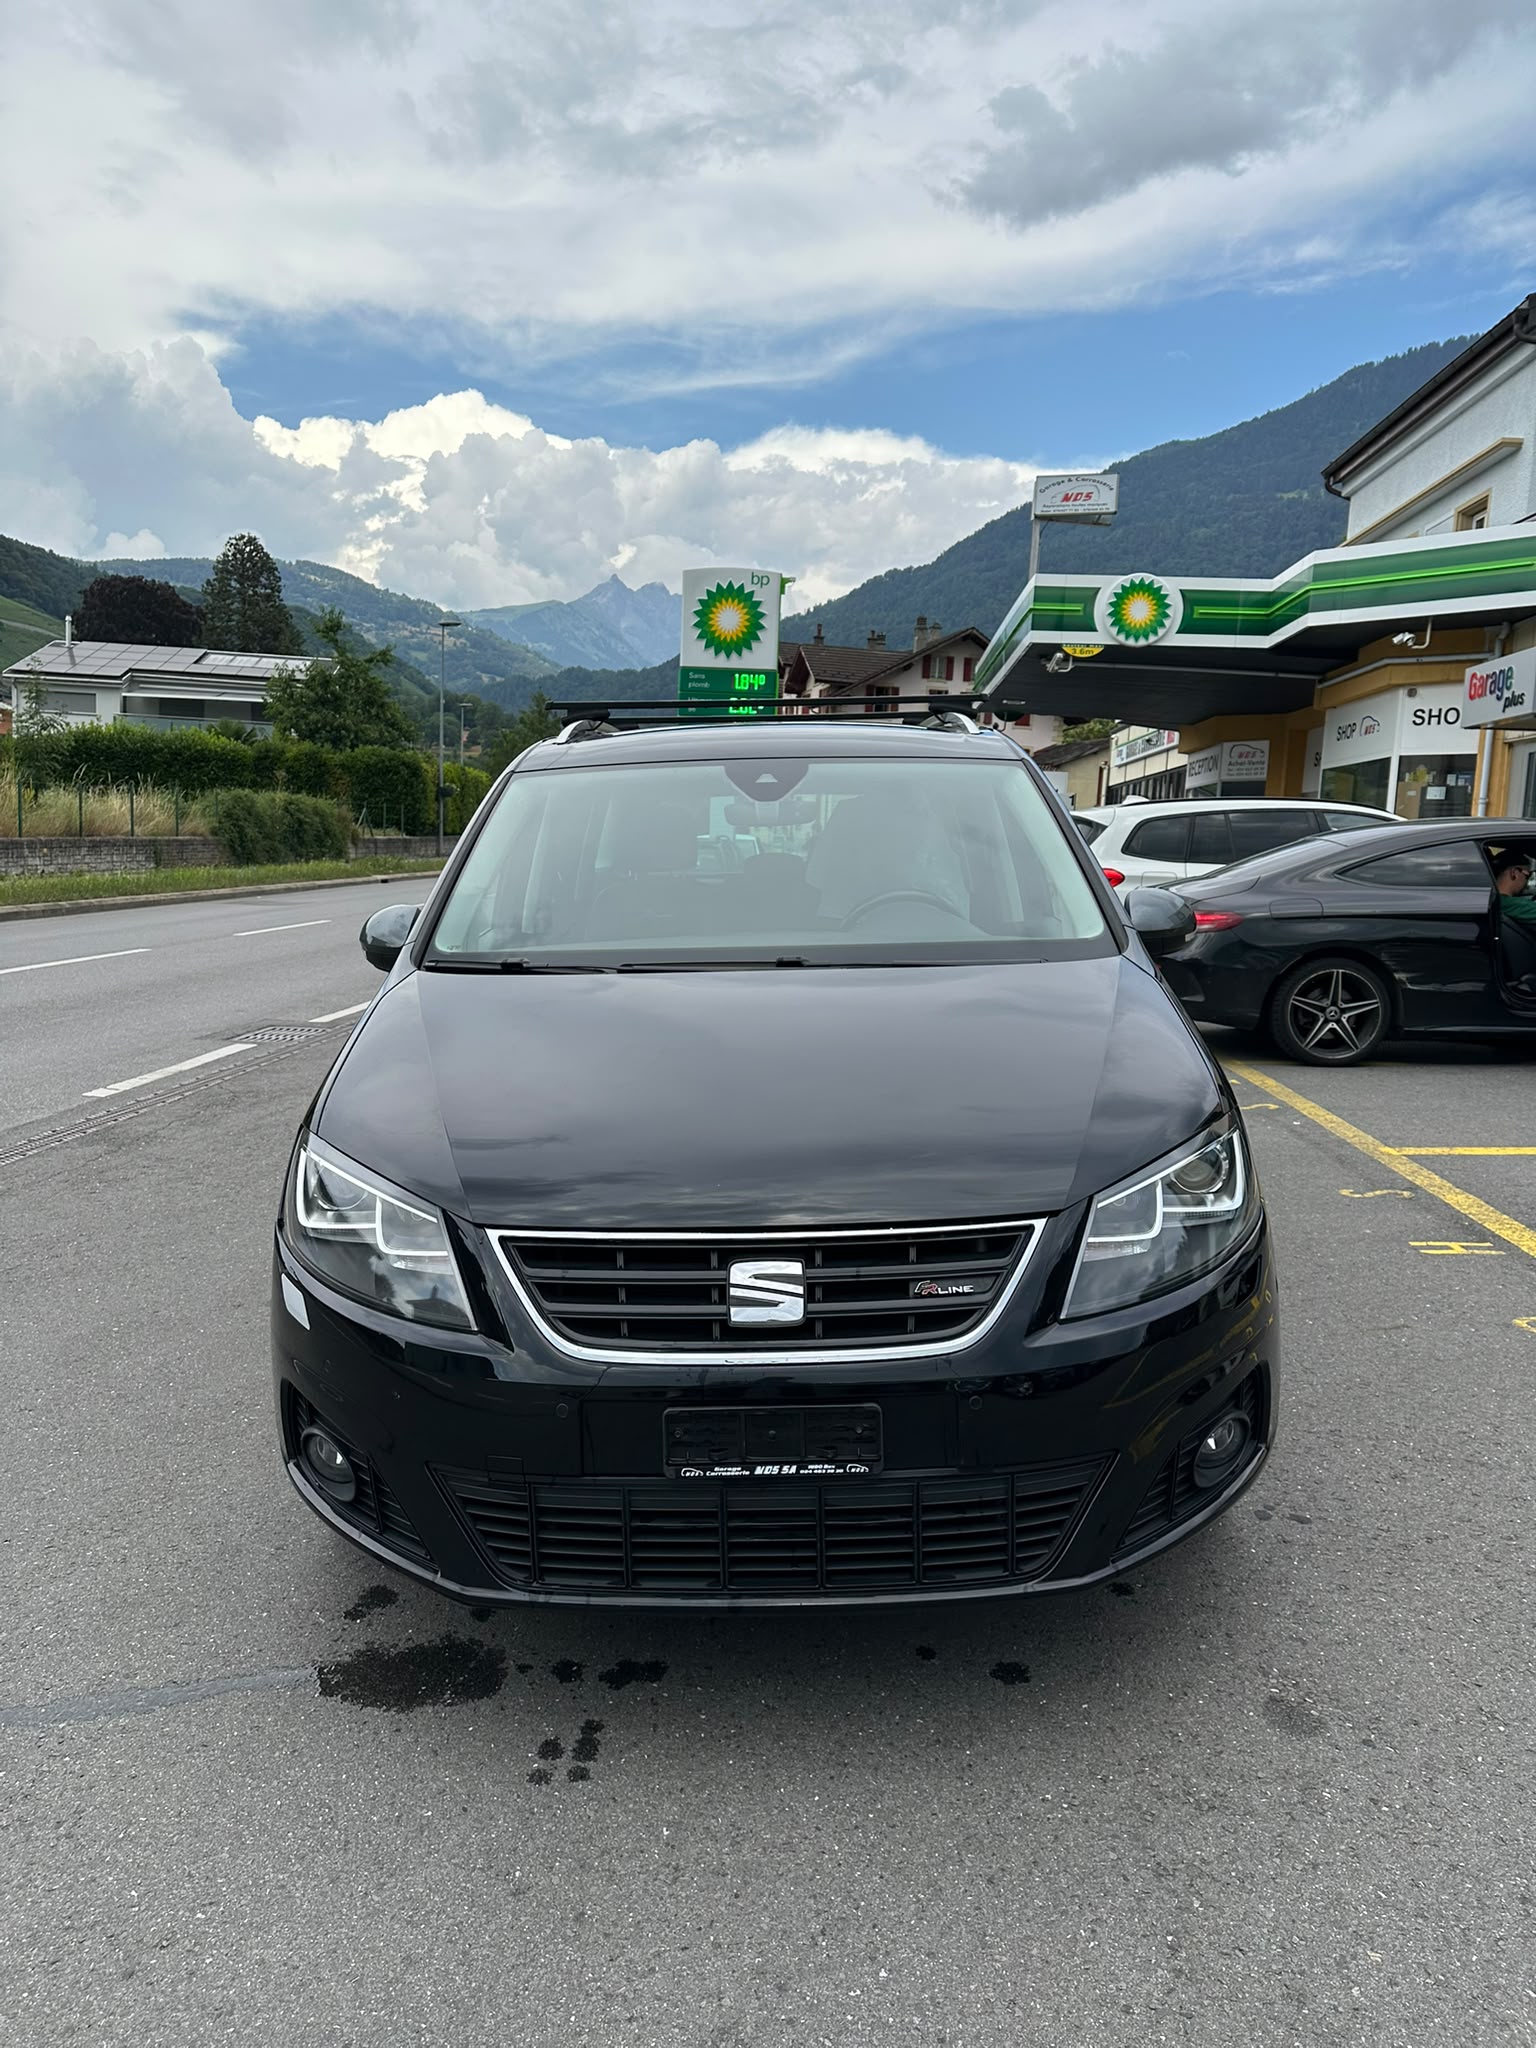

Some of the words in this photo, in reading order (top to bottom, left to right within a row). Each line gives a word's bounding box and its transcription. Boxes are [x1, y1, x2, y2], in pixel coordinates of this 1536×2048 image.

[751, 571, 771, 589] bp
[687, 681, 711, 689] plomb
[688, 671, 706, 679] Sans
[1468, 666, 1514, 701] Garage
[1502, 690, 1526, 713] plus
[1412, 706, 1461, 726] SHO
[1336, 722, 1357, 742] SHOP
